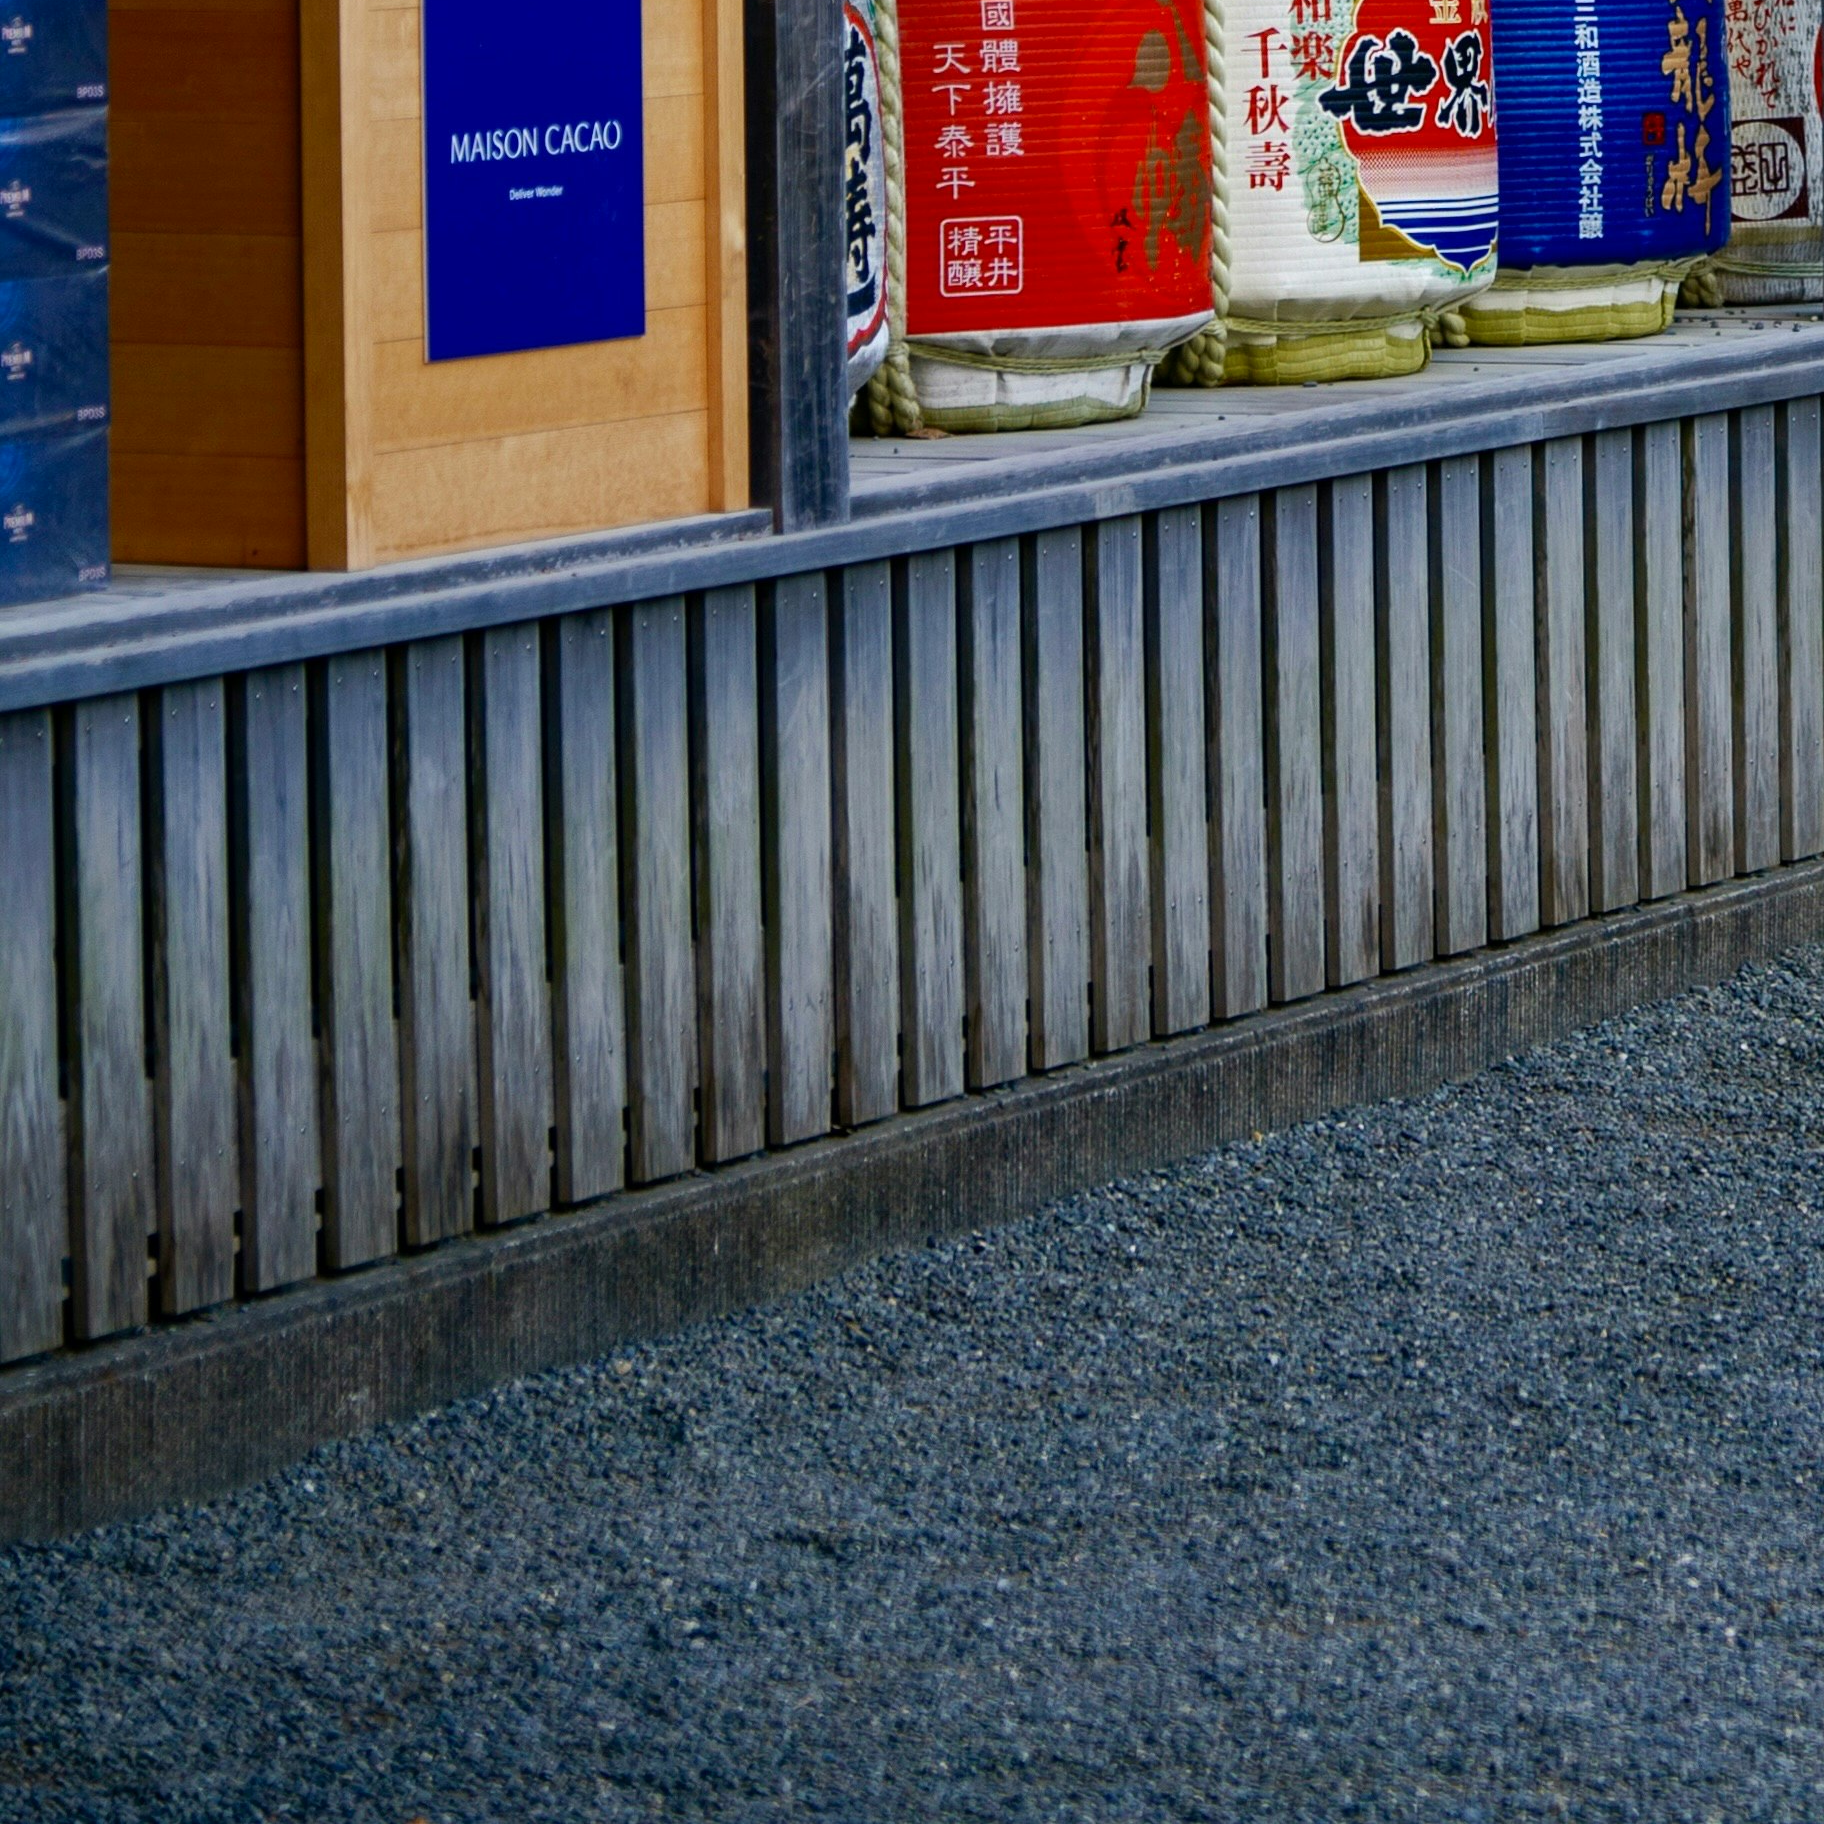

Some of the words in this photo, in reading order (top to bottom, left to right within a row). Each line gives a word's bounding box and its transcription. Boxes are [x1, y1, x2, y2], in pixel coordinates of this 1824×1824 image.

[450, 126, 538, 165] MAISON
[545, 119, 622, 156] CACAO
[930, 42, 976, 201] 天下泰平
[510, 188, 534, 201] Deliver
[536, 185, 564, 198] Wonder
